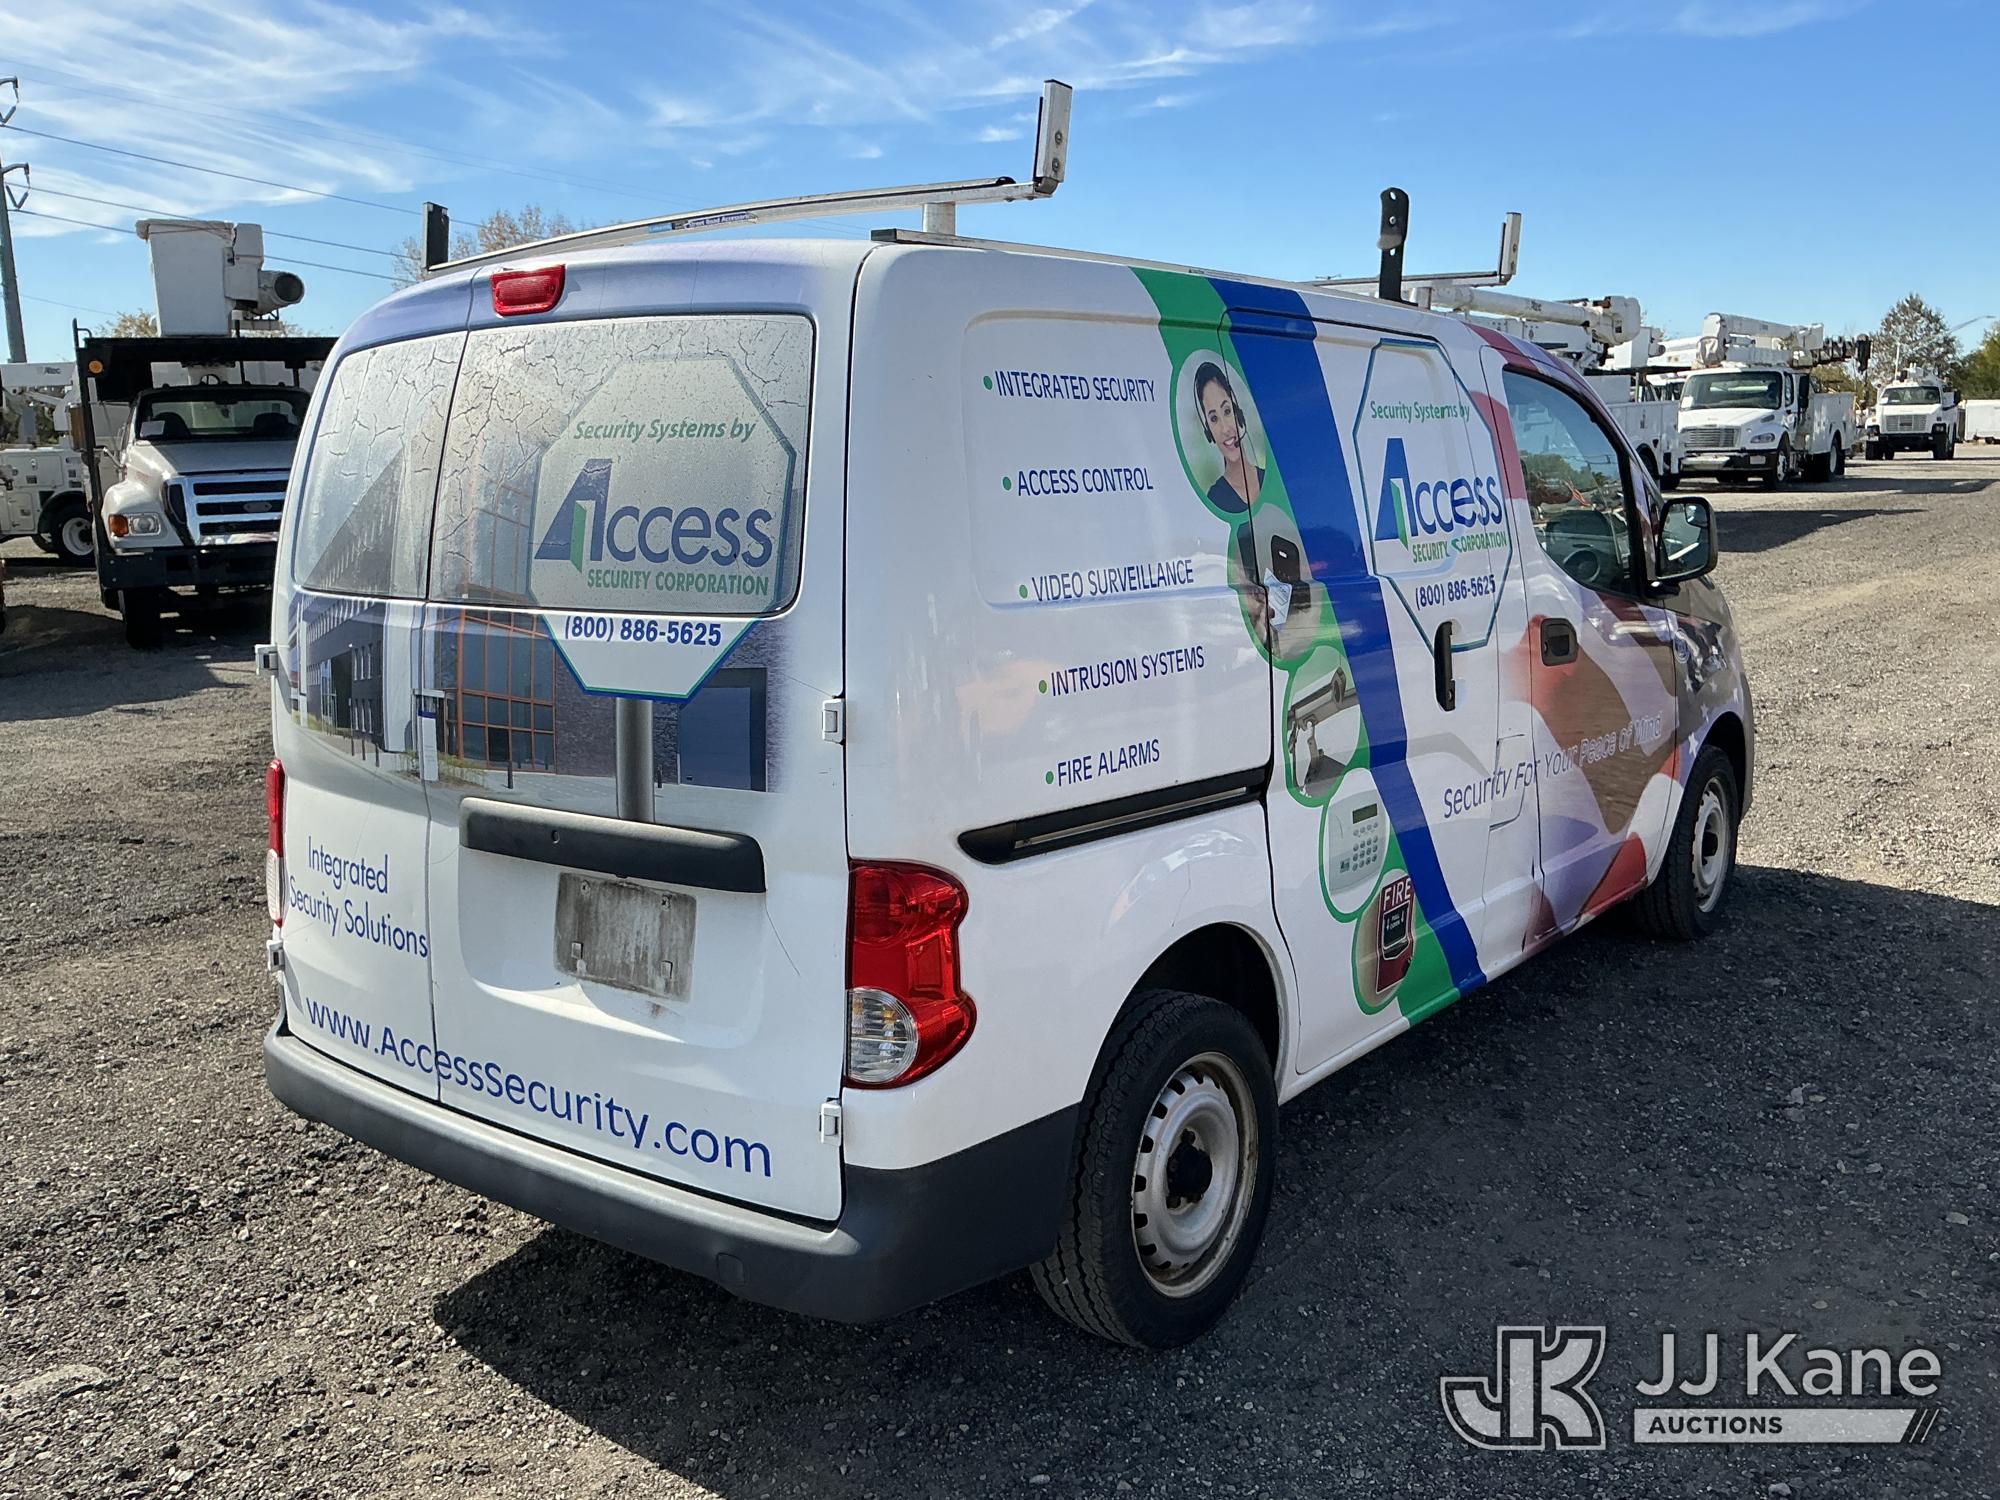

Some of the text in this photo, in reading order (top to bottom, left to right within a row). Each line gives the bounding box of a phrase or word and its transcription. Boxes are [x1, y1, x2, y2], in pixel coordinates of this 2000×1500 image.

[995, 371, 1155, 402] INTEGRATED SECURITY
[574, 418, 756, 444] Security Systems by
[1370, 400, 1470, 424] Security Systems by
[1017, 467, 1153, 496] ACCESS CONTROL
[1375, 438, 1502, 550] Access
[534, 458, 773, 574] Access
[1412, 531, 1507, 563] SECURITY CORPORATION
[587, 569, 769, 596] SECURITY CORPORATION
[1032, 559, 1194, 602] VIDEO SURVEILLANCE
[1415, 574, 1496, 610] (800) 886-5625
[564, 615, 722, 647] (800) 886-5625
[1051, 646, 1205, 697] INTRUSION SYSTEMS
[1057, 739, 1160, 787] FIRE ALARMS
[1444, 711, 1663, 818] Security For Your Peace of Mind
[308, 835, 388, 894] Integrated
[1384, 878, 1411, 911] FIRE
[289, 875, 428, 958] Security Solutions
[306, 997, 772, 1177] www.AccessSecurity.com
